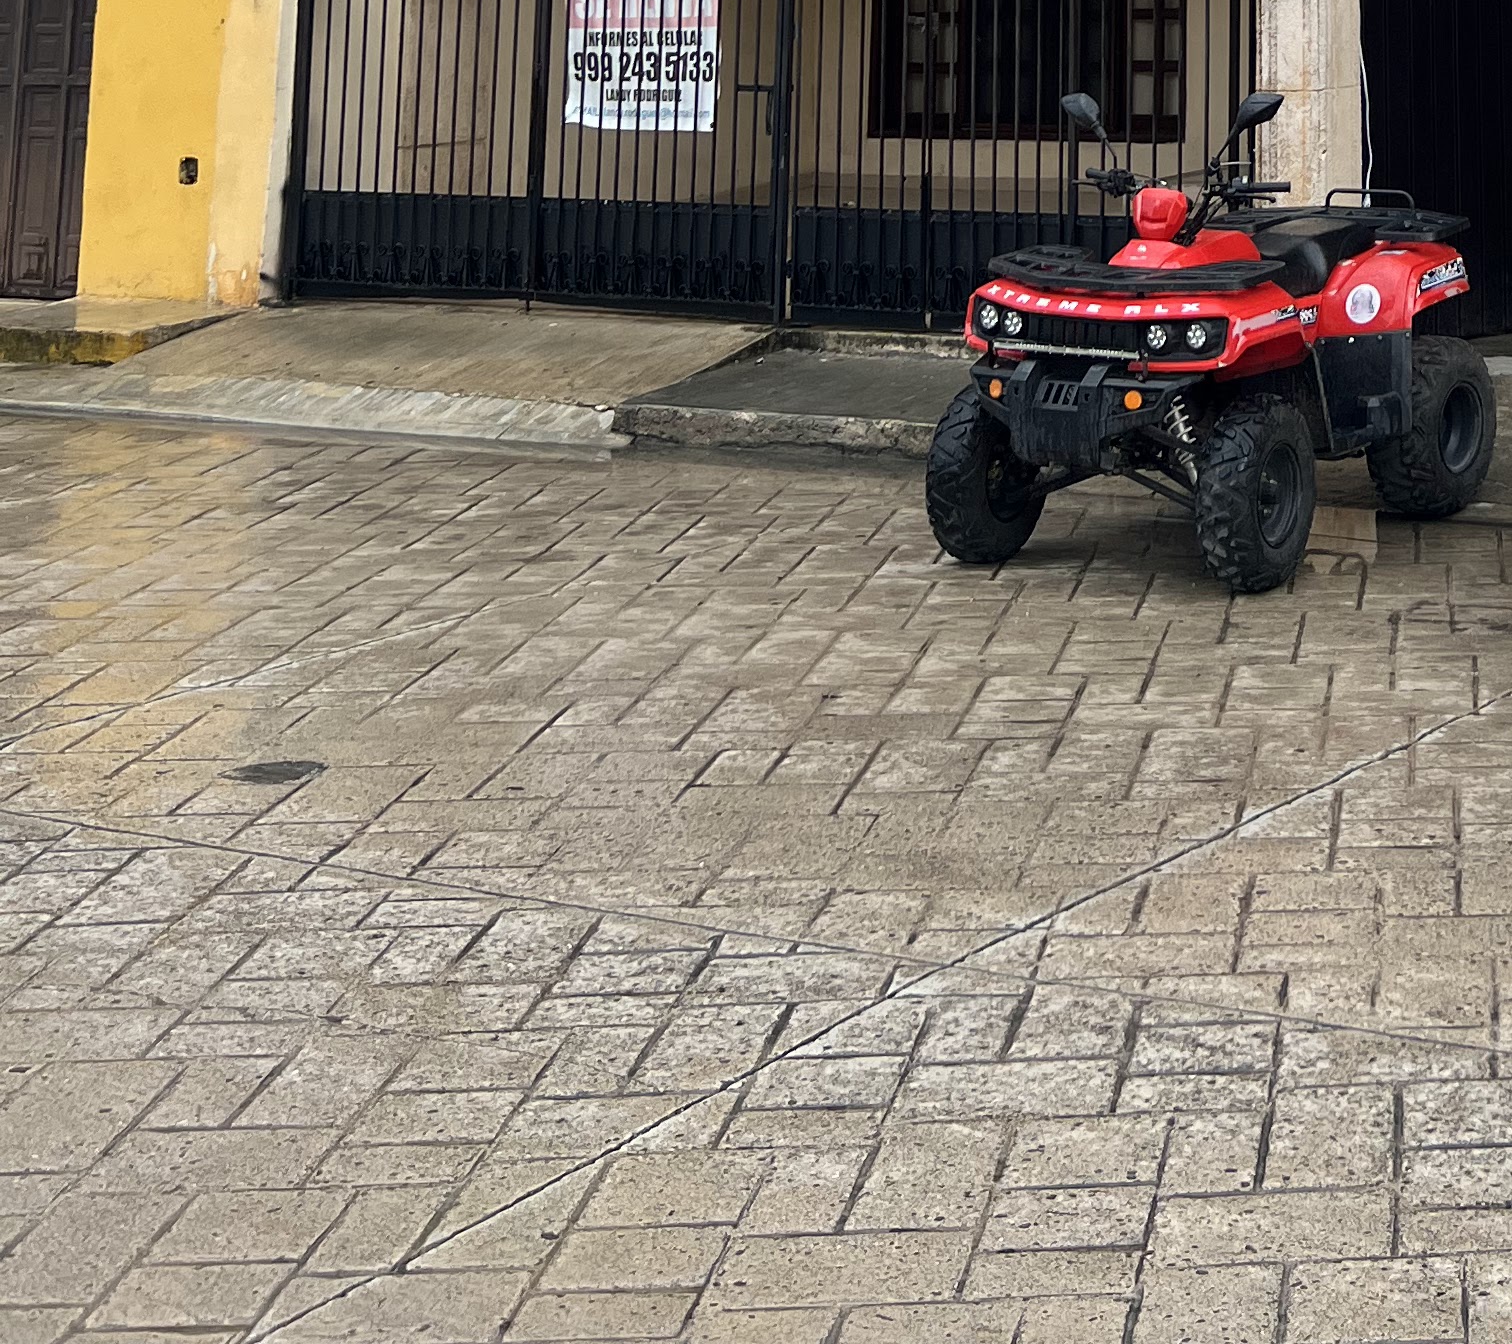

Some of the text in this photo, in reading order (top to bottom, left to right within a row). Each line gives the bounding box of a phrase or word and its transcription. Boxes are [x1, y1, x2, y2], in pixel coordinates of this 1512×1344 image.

[573, 51, 715, 83] 999 243 5133
[987, 284, 1102, 313] XTREME
